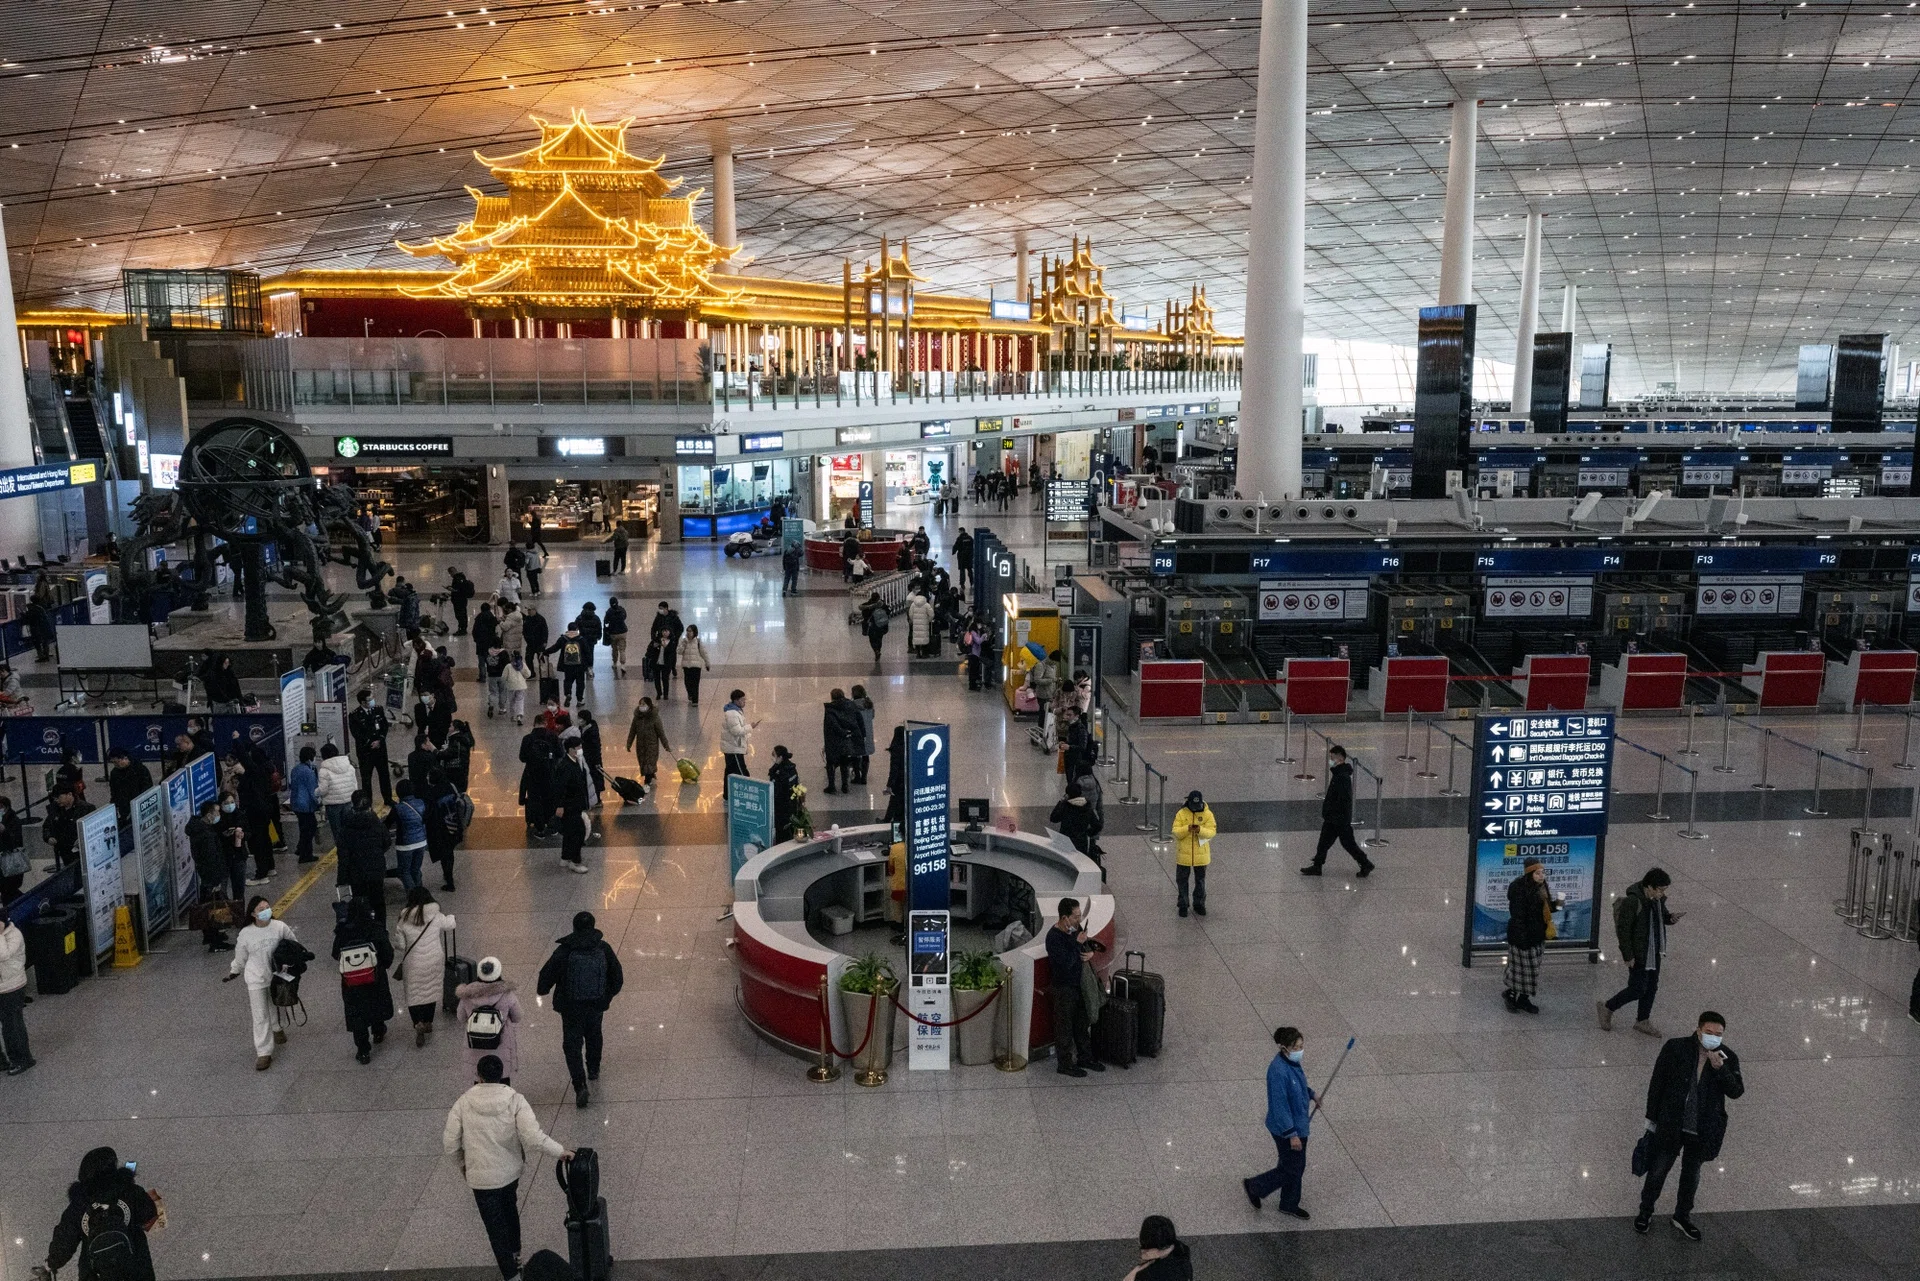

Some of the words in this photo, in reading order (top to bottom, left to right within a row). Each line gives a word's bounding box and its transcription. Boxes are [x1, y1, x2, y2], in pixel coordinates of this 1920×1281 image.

[362, 443, 414, 451] STARBUCKS
[416, 443, 448, 451] COFFEE
[1155, 558, 1172, 568] F18
[1253, 558, 1270, 568] F17
[1382, 558, 1400, 566] F16
[1477, 557, 1494, 567] F15
[1604, 556, 1620, 565] F14
[1697, 555, 1714, 565] F13
[1820, 554, 1837, 564] F12
[1530, 719, 1559, 729] 安全检查
[1587, 718, 1606, 727] 登机口
[914, 784, 946, 796] 问讯服务时间
[1526, 794, 1545, 803] 停车场
[1568, 793, 1580, 801] 地铁
[734, 799, 764, 812] 第一责任人
[915, 815, 945, 828] 首都机场
[1525, 819, 1541, 828] 餐饮
[915, 824, 945, 836] 服务热线
[931, 832, 947, 840] Capital
[916, 841, 944, 851] International
[1520, 844, 1568, 855] D01-D58
[914, 858, 946, 875] 96158
[918, 1013, 941, 1024] 航空
[917, 1025, 942, 1035] 保险
